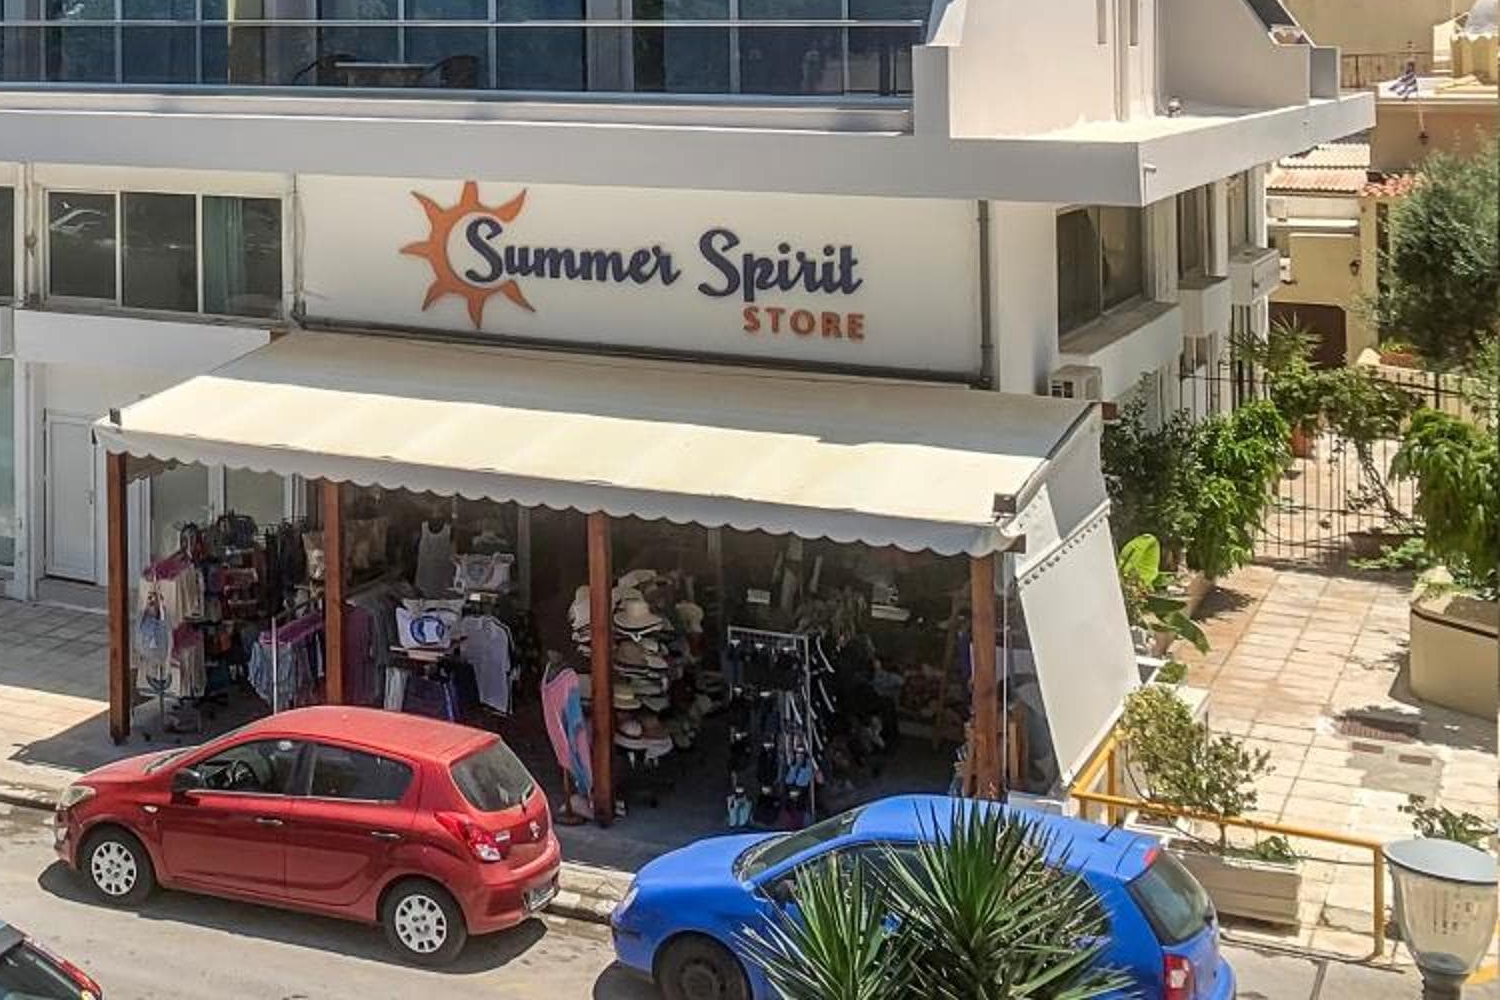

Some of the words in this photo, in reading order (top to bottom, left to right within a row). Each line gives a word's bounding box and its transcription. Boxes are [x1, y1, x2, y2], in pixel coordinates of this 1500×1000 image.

[464, 216, 681, 285] Summer
[697, 227, 864, 303] Spirit
[742, 306, 865, 341] STORE
